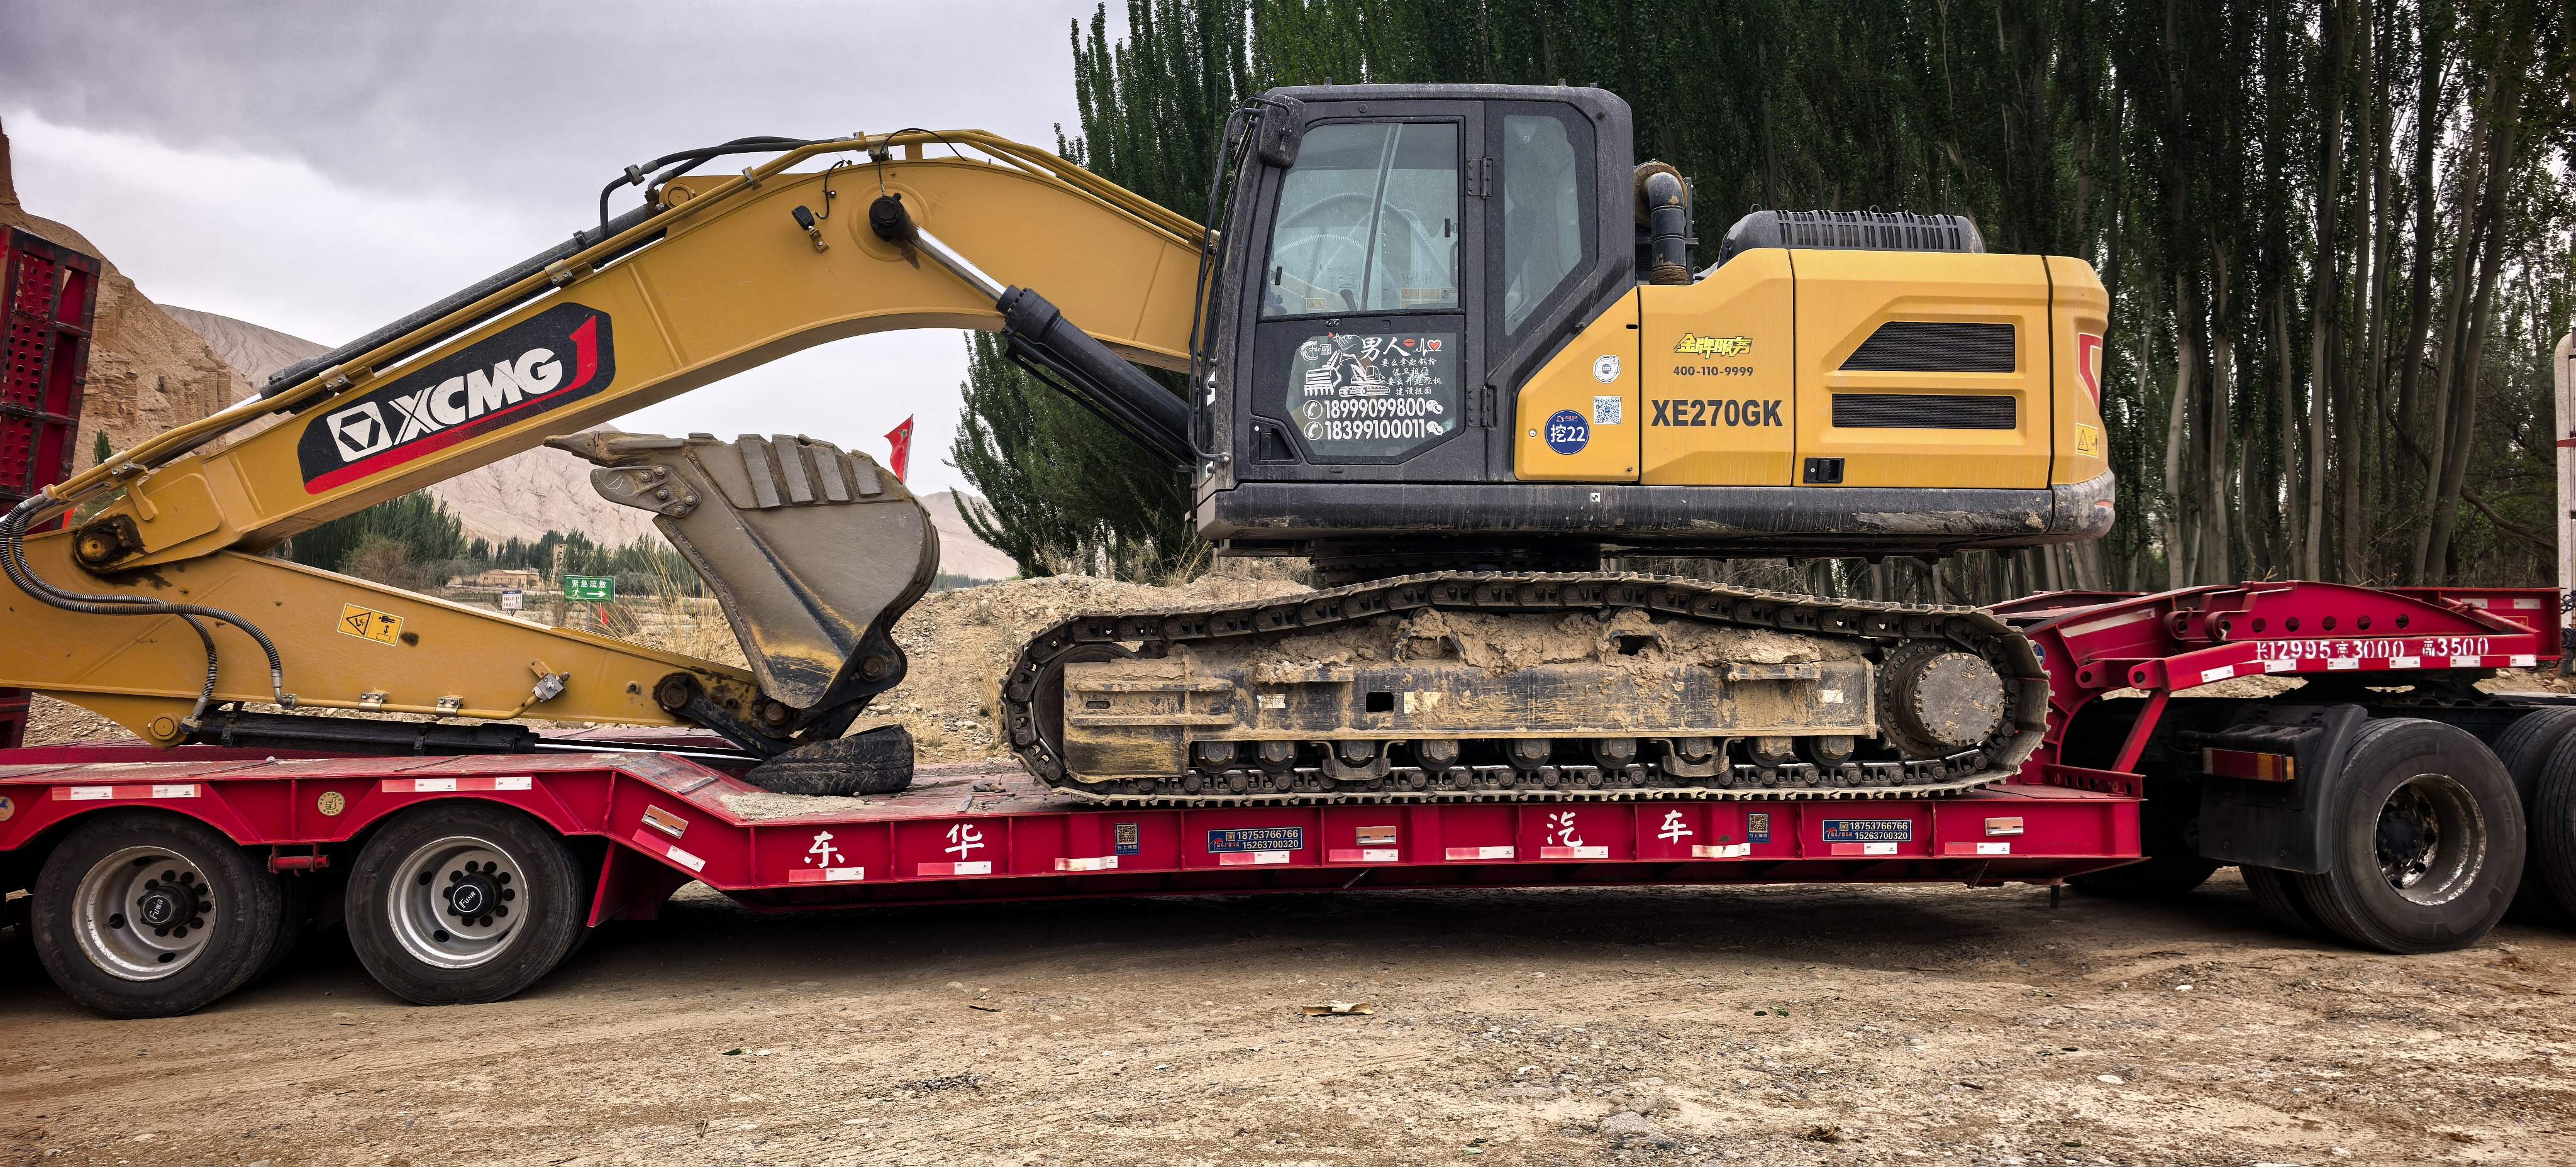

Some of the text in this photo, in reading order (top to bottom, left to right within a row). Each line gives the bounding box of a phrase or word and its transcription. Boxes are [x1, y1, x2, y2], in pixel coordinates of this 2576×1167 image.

[1360, 337, 1411, 361] 男人
[1674, 333, 1753, 359] 金牌服务
[1674, 366, 1753, 376] 400-110-9999
[388, 348, 563, 444] XCMG
[1324, 397, 1426, 419] 18999099800
[1651, 399, 1784, 427] XE270GK
[1324, 419, 1426, 440] 18399100011
[1550, 424, 1585, 443] 挖22
[572, 579, 607, 589] 紧急疏散
[2422, 637, 2489, 657] 高3500
[1236, 829, 1299, 840] 18753766766
[1850, 821, 1908, 830] 18753766766
[804, 809, 1693, 869] 东 华 汽 车
[1242, 839, 1299, 849] 15263700320
